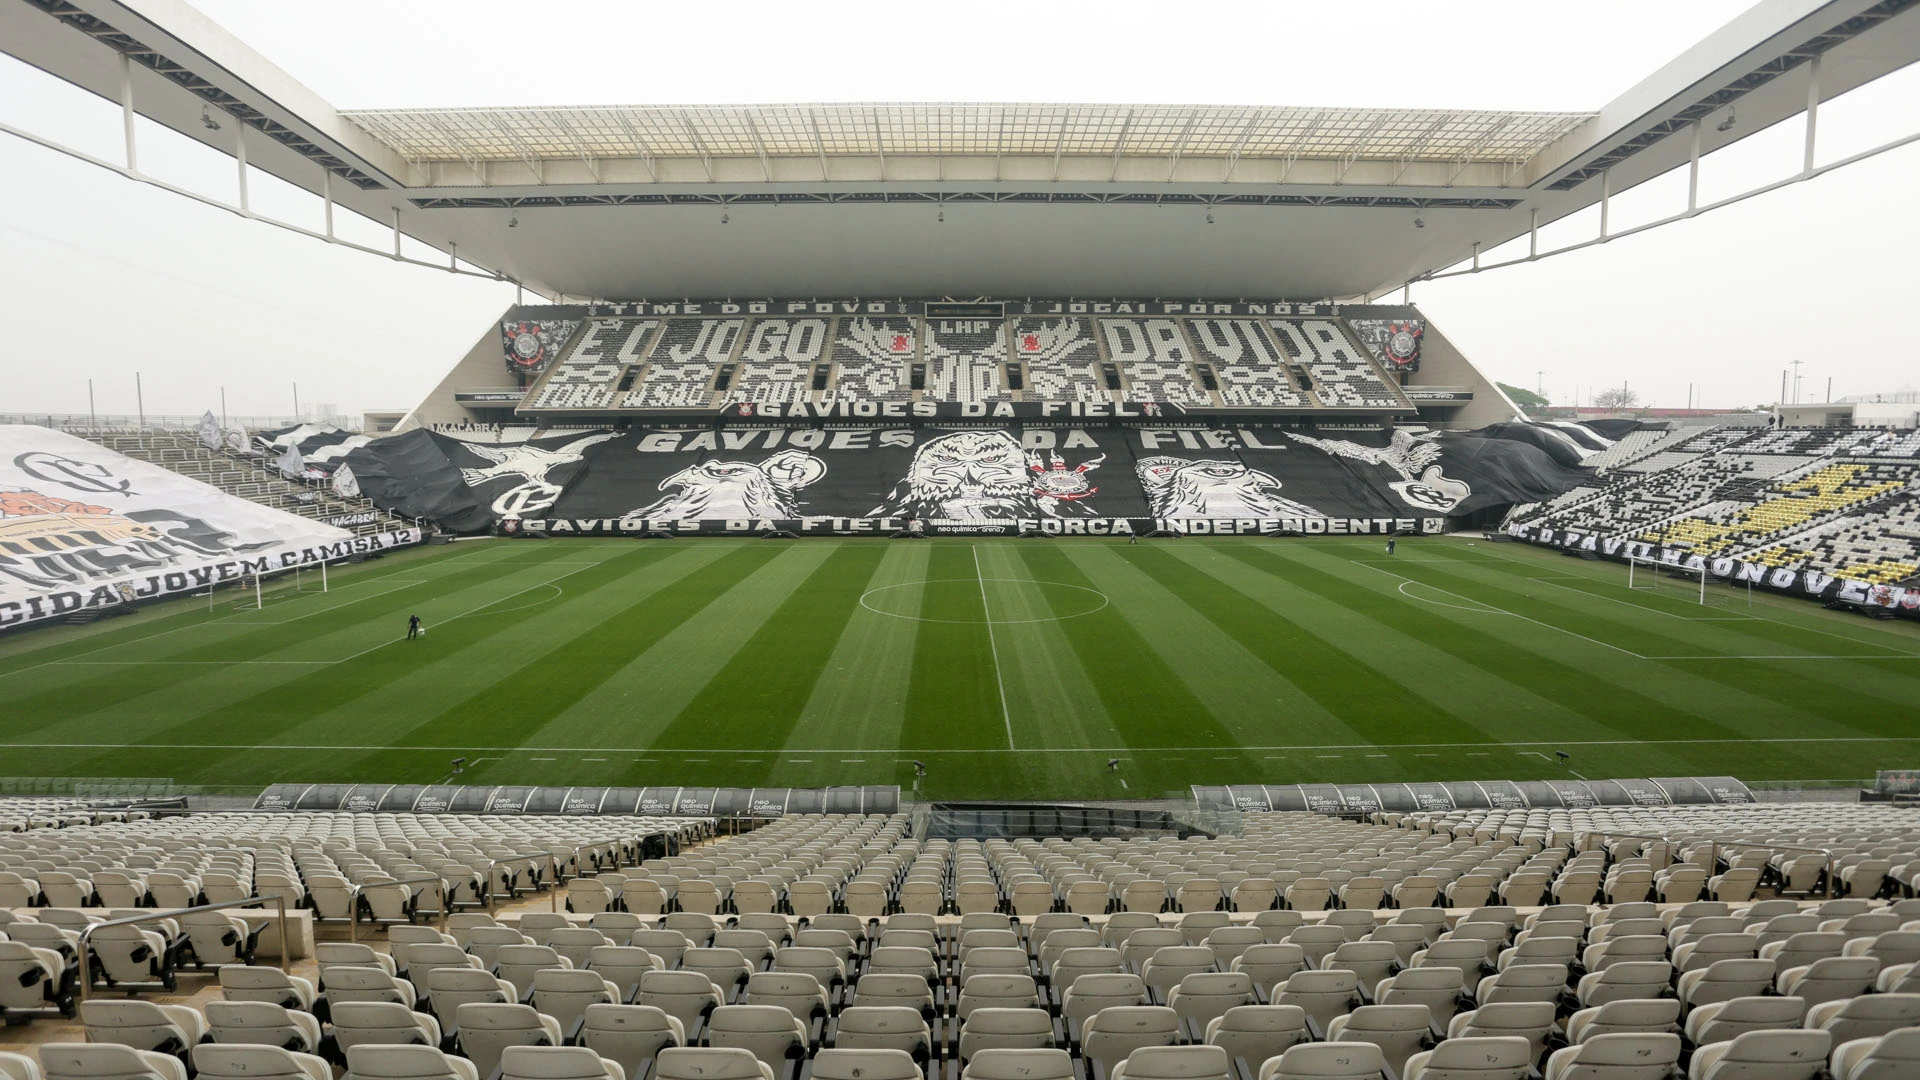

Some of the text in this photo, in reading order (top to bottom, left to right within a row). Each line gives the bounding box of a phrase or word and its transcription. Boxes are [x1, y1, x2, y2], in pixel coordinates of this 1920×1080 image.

[610, 303, 885, 315] TIME DO POVO
[1049, 303, 1145, 313] JOGAI
[1164, 303, 1232, 314] POR
[940, 320, 990, 334] LHP
[962, 402, 1016, 417] DA
[1042, 402, 1140, 417] FIEL
[1022, 430, 1100, 449] DA
[1140, 430, 1288, 450] FIEL
[725, 519, 777, 531] DA
[802, 519, 904, 531] FIEL
[1156, 518, 1416, 534] INDEPENDENTE
[136, 556, 270, 597] JOVEM
[280, 534, 384, 576] CAMISA
[392, 529, 413, 544] 12
